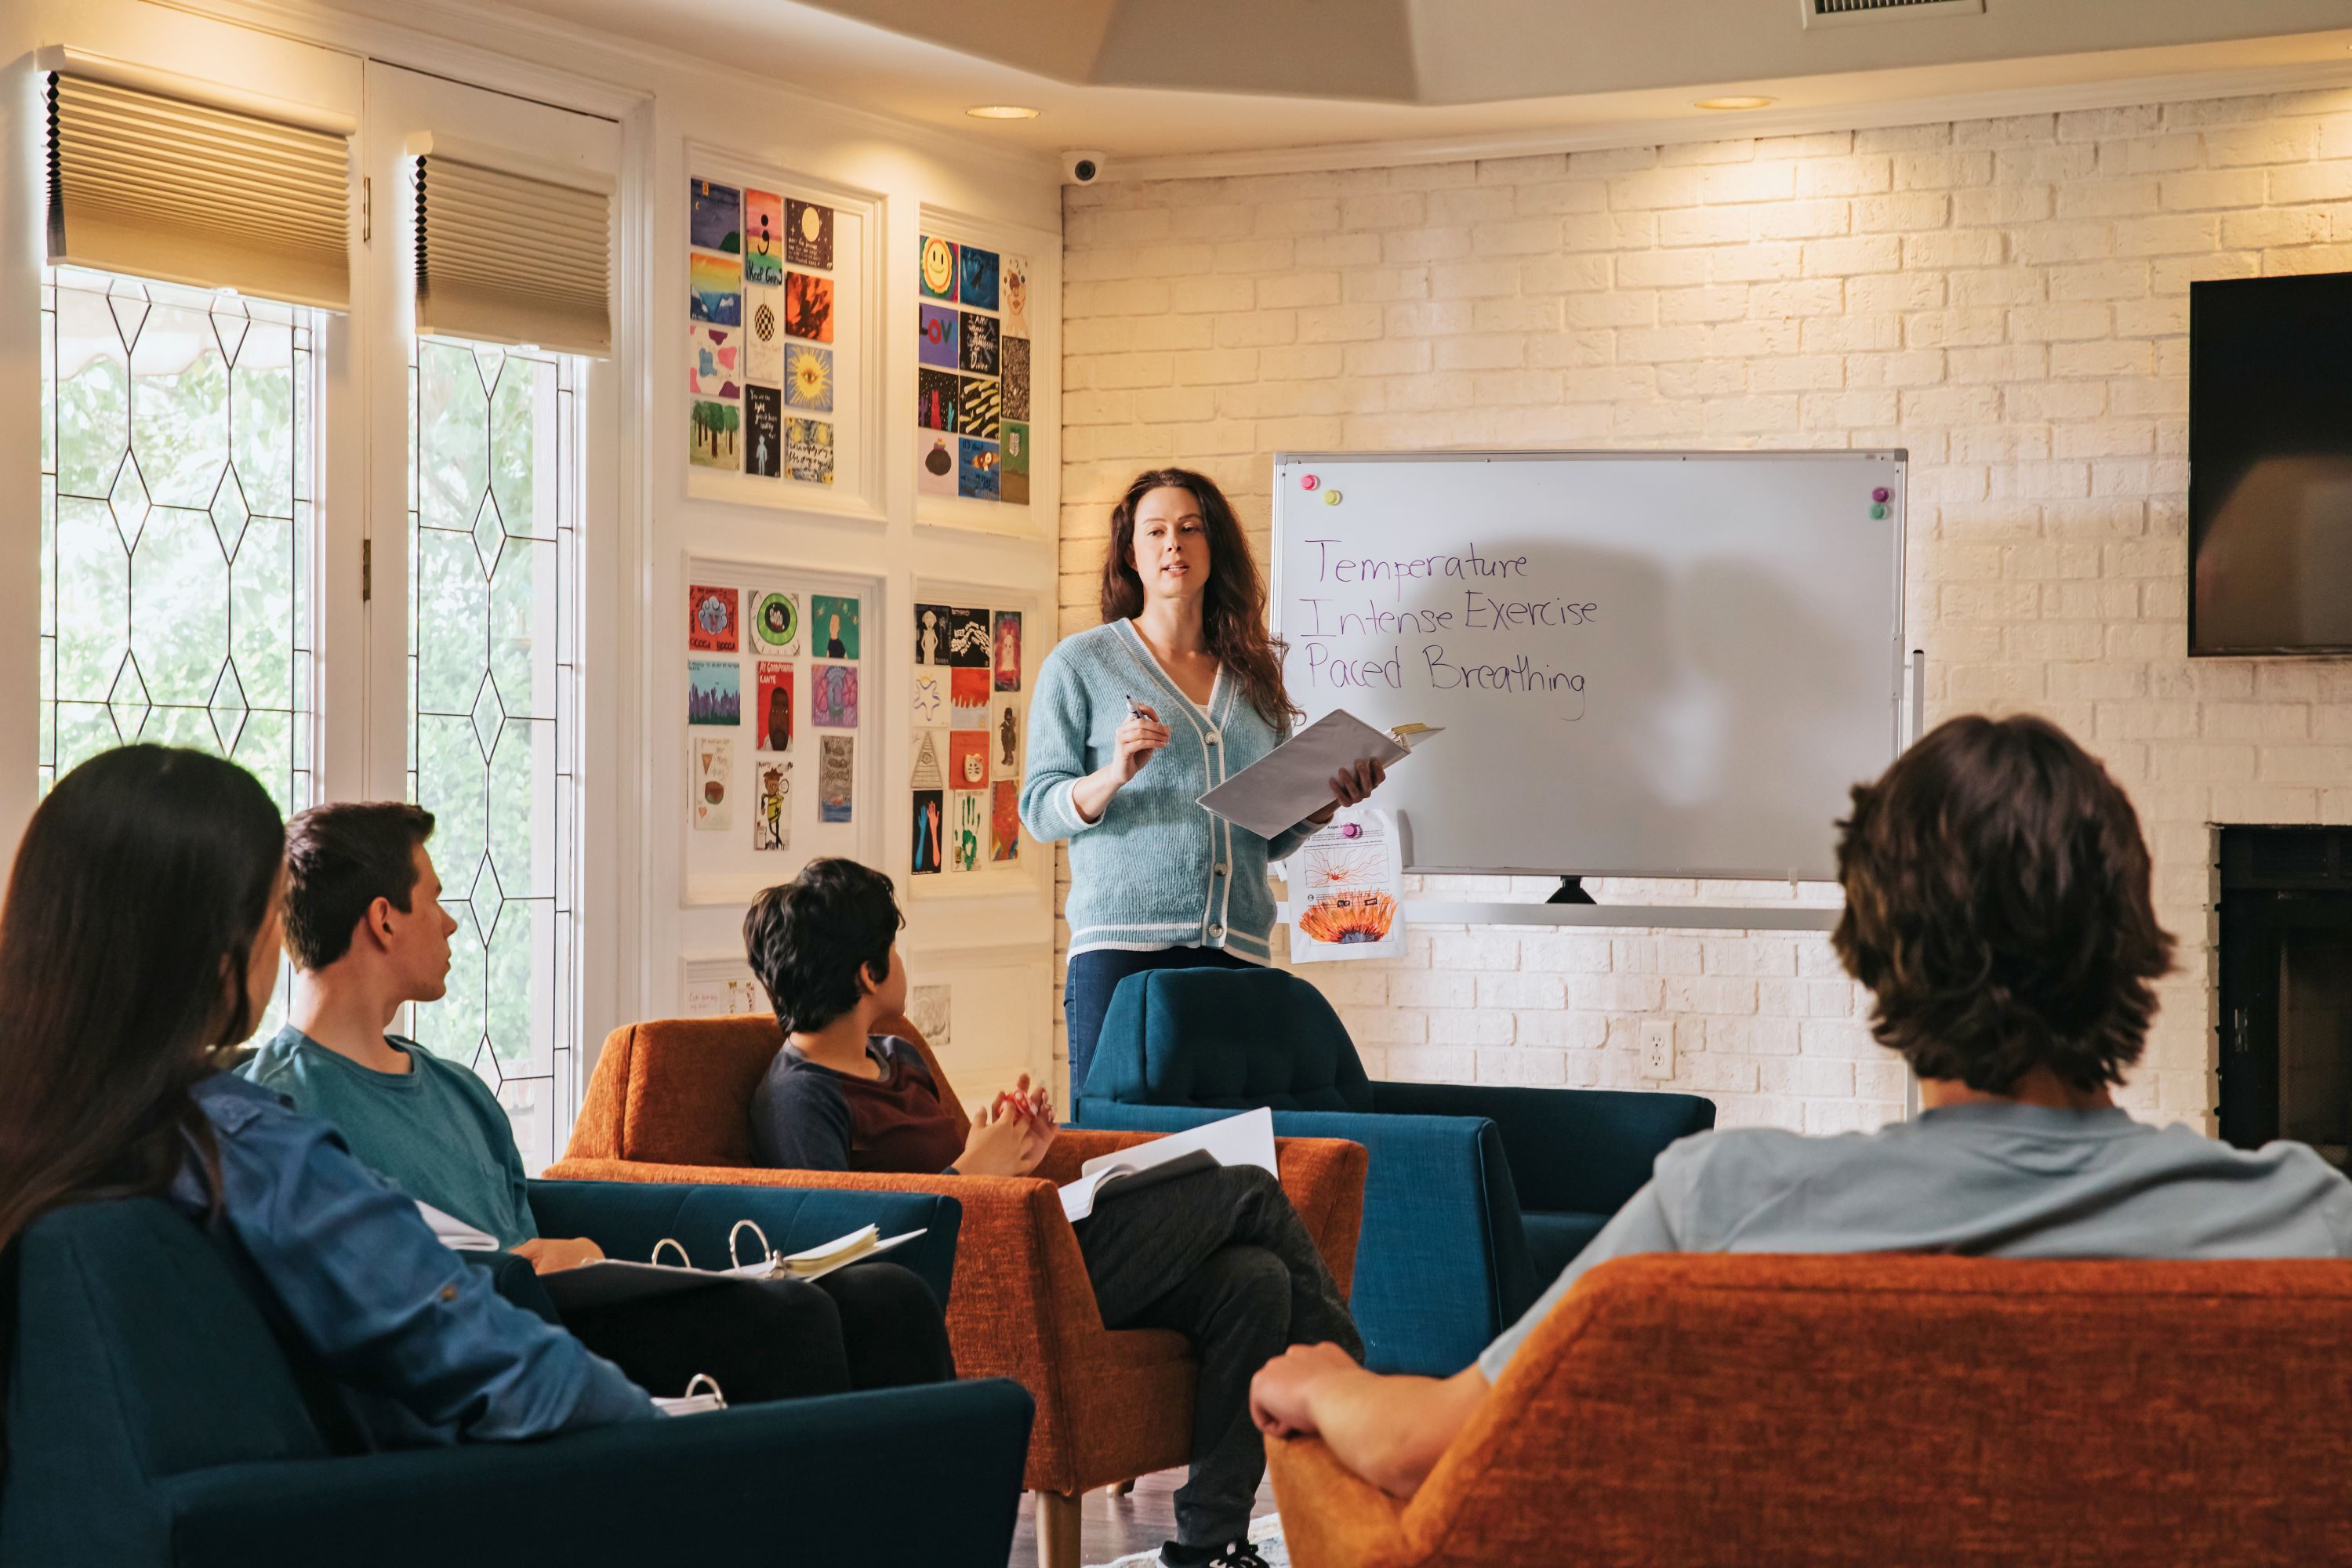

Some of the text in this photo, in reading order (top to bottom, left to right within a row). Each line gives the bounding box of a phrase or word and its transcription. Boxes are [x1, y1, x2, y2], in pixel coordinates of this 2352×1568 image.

[1303, 539, 1529, 603] Temperature
[1298, 589, 1598, 637] Intense Exercise
[1305, 642, 1585, 721] Paced Breathing
